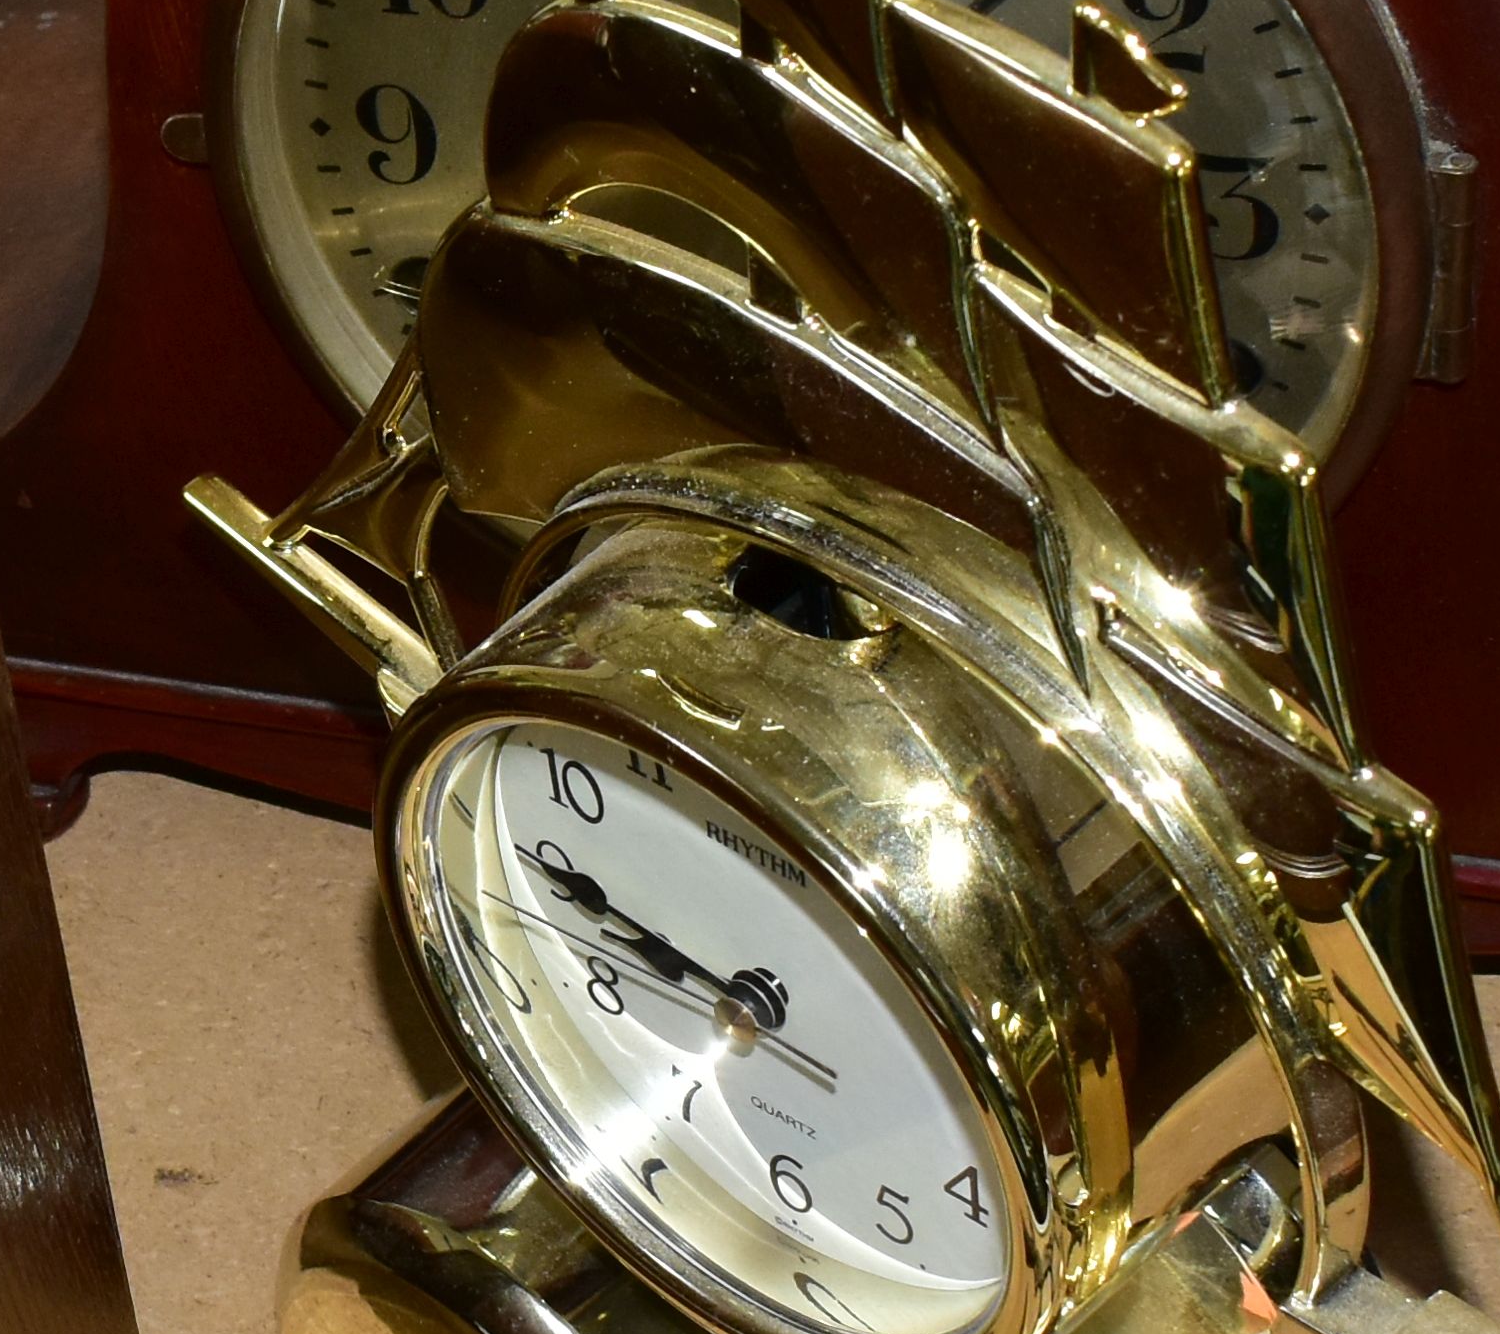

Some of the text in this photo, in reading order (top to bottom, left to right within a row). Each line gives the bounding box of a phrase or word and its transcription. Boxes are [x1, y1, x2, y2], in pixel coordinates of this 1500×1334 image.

[355, 84, 437, 185] 9
[539, 747, 604, 824] 10
[705, 819, 807, 888] RHYTHM
[587, 955, 624, 1015] 8
[750, 1095, 817, 1140] QUARTZ
[769, 1154, 813, 1214] 6
[875, 1184, 914, 1245] 5
[943, 1165, 989, 1228] 4
